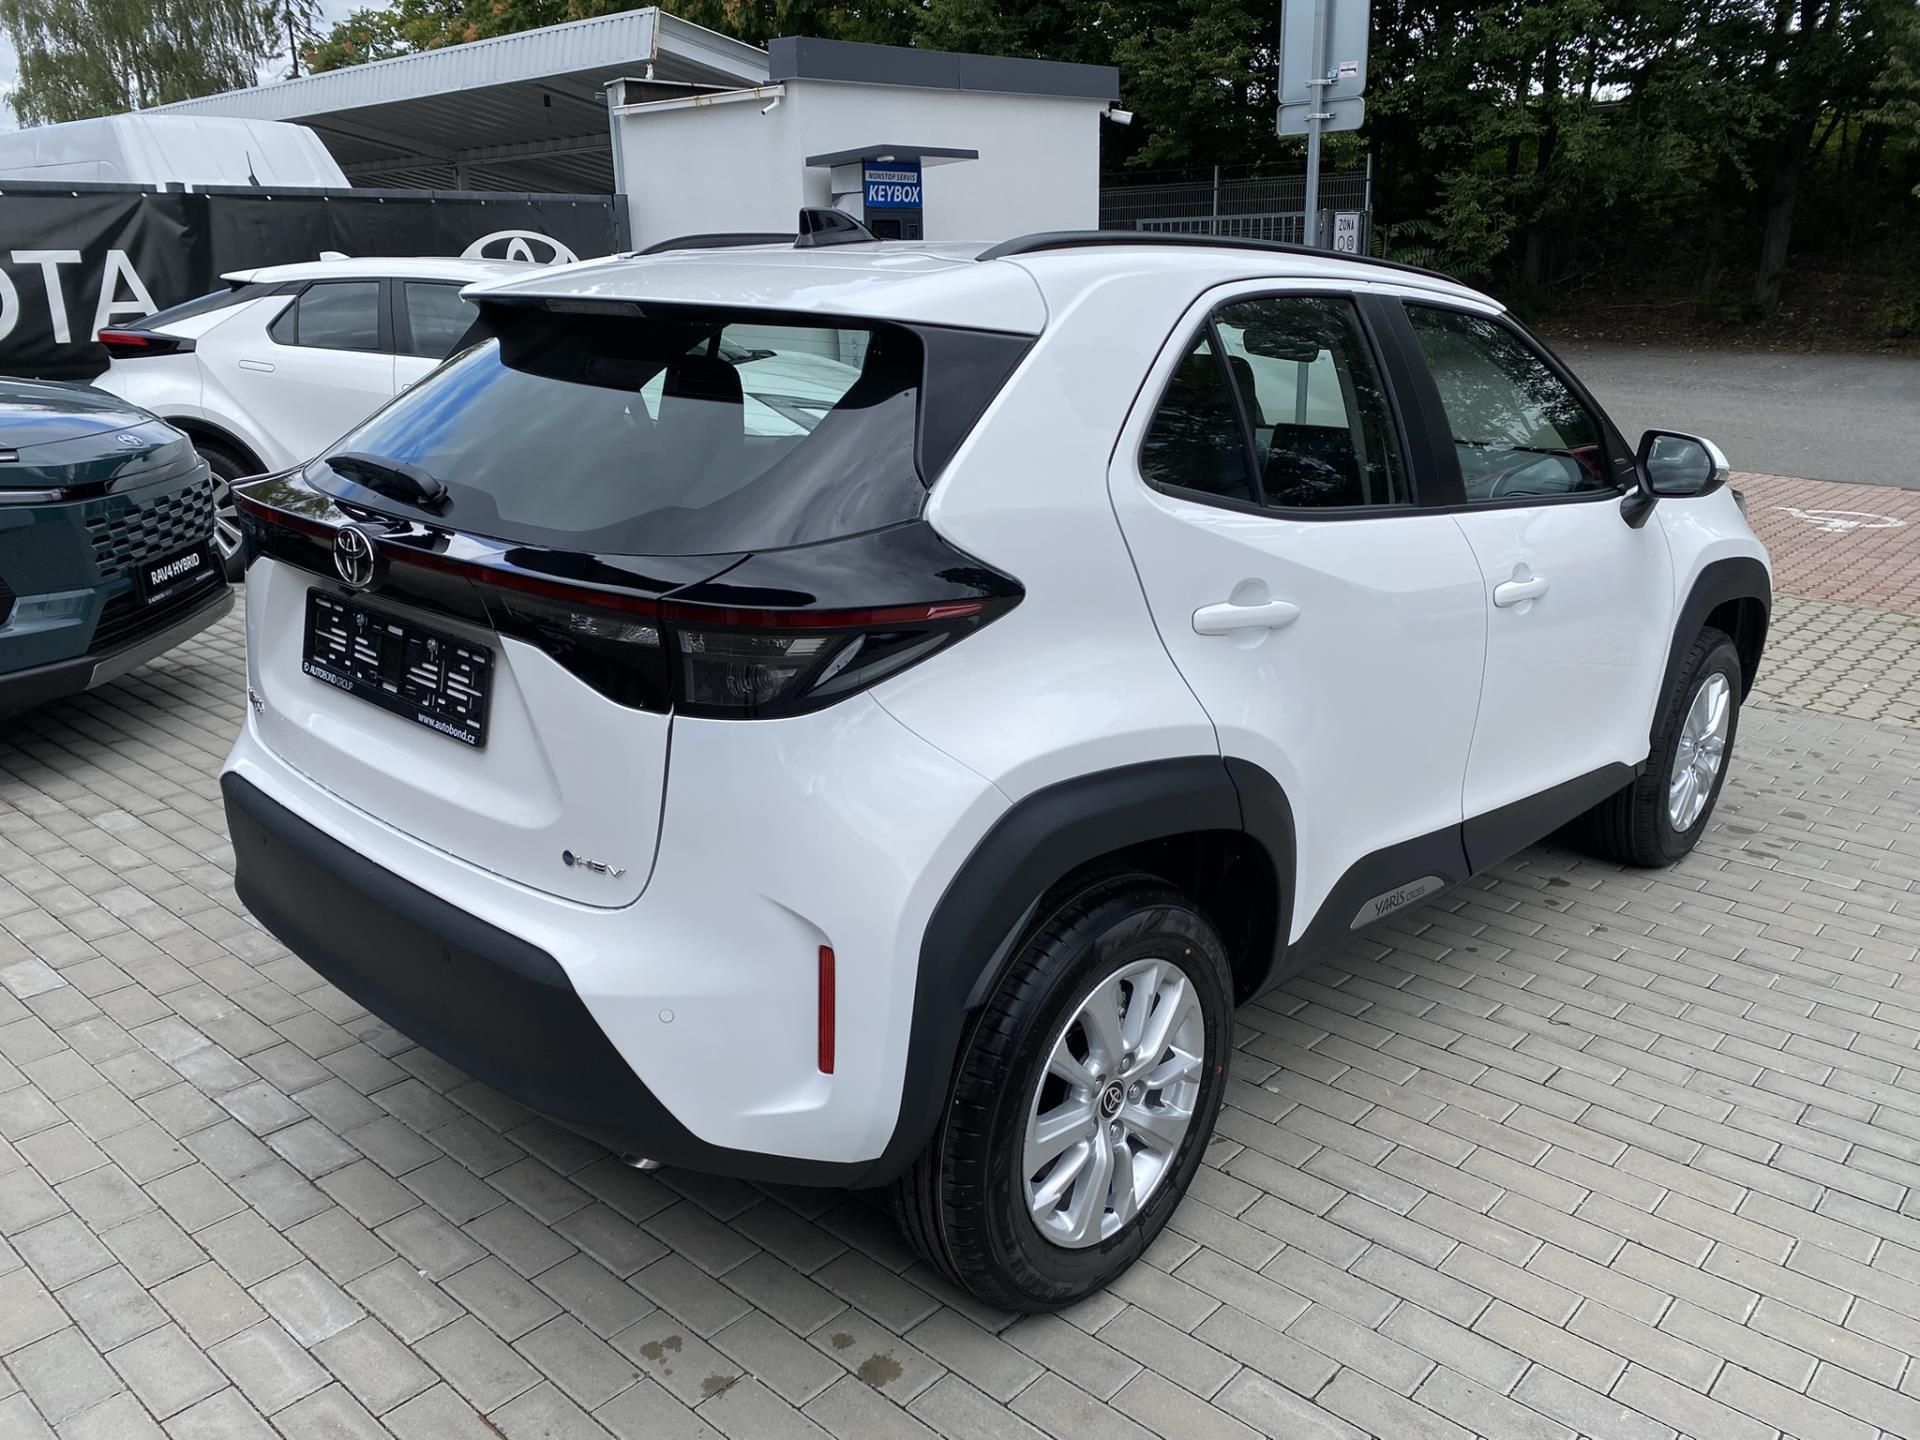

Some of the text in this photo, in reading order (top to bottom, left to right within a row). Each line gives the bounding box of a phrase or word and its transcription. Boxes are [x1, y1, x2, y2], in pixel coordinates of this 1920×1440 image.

[868, 171, 916, 182] NONSTOP SERVIS
[868, 184, 920, 203] KEYBOX
[150, 562, 174, 585] RAV4
[172, 552, 200, 576] HYBRID
[309, 664, 354, 691] AUTOBOND GROUP
[417, 712, 476, 744] www.autobond.cz
[1375, 890, 1405, 916] YARIS
